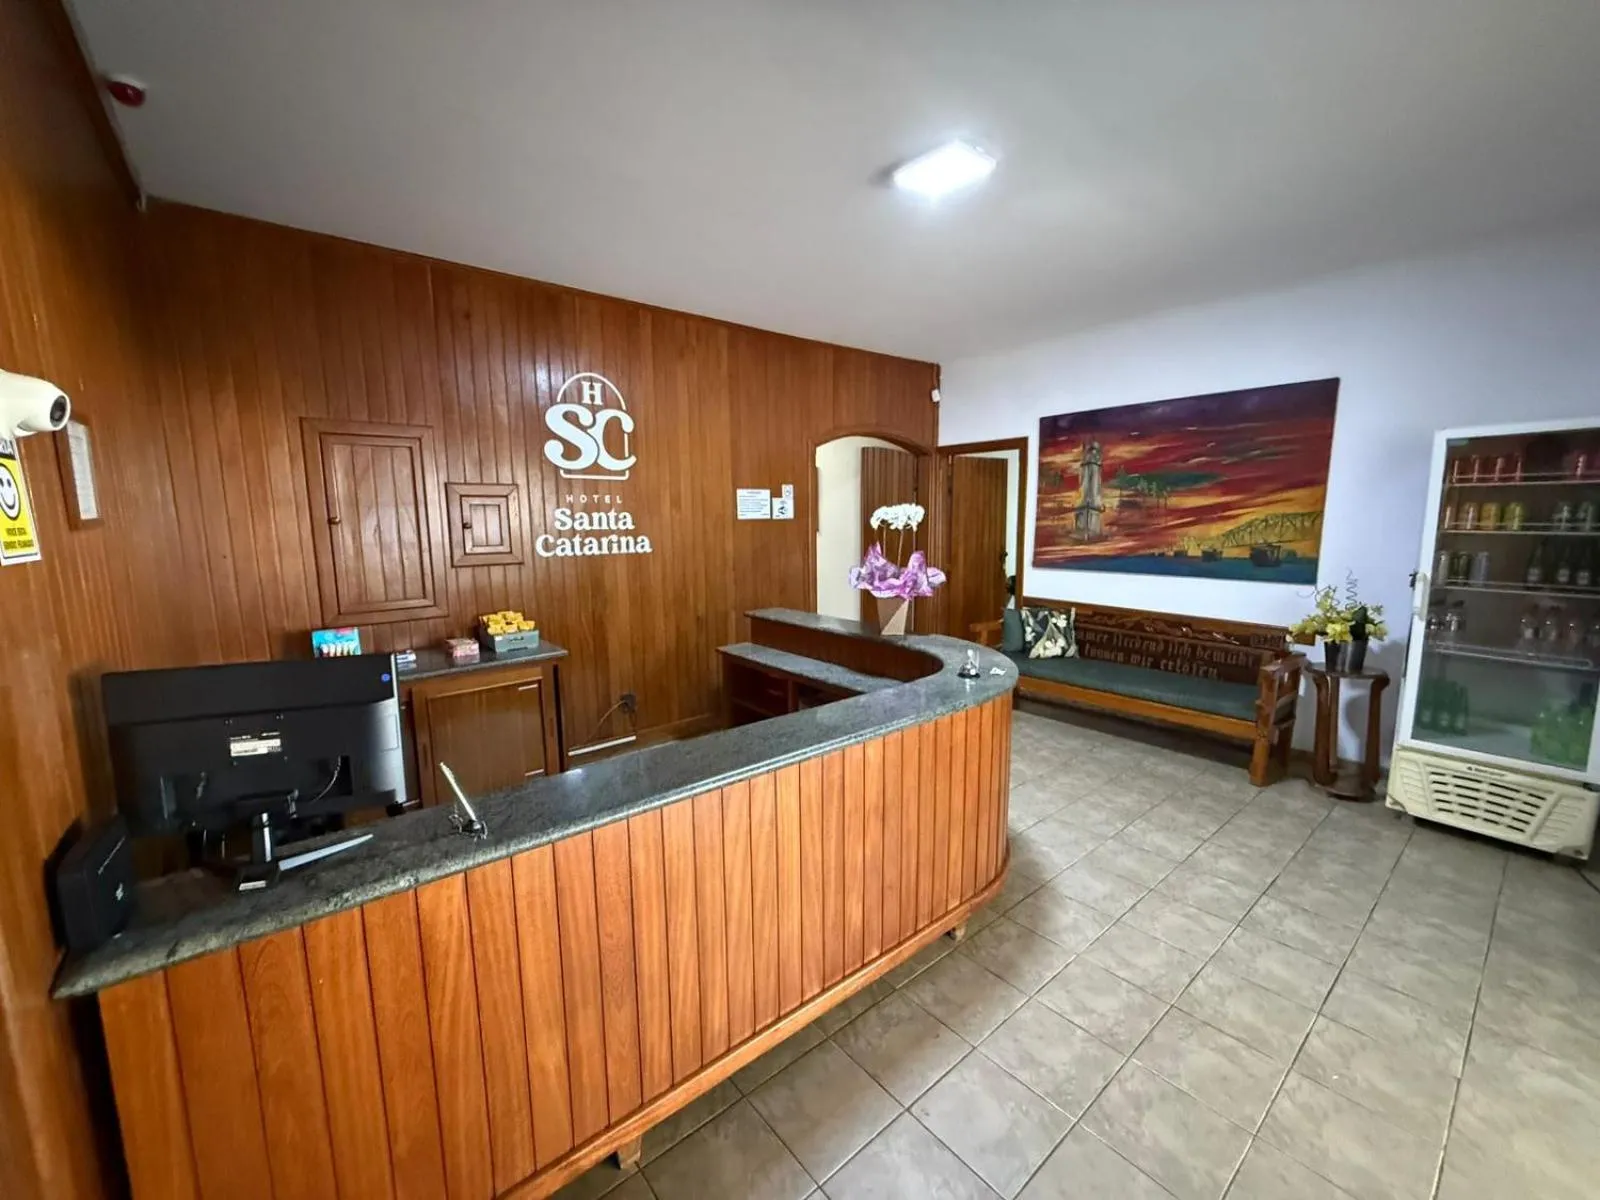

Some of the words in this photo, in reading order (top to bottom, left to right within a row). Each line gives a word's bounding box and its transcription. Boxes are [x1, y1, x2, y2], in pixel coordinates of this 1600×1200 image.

[581, 381, 603, 405] H
[544, 403, 637, 471] SC
[565, 494, 623, 504] HOTEL
[554, 508, 635, 530] Santa
[535, 533, 653, 557] Catarina
